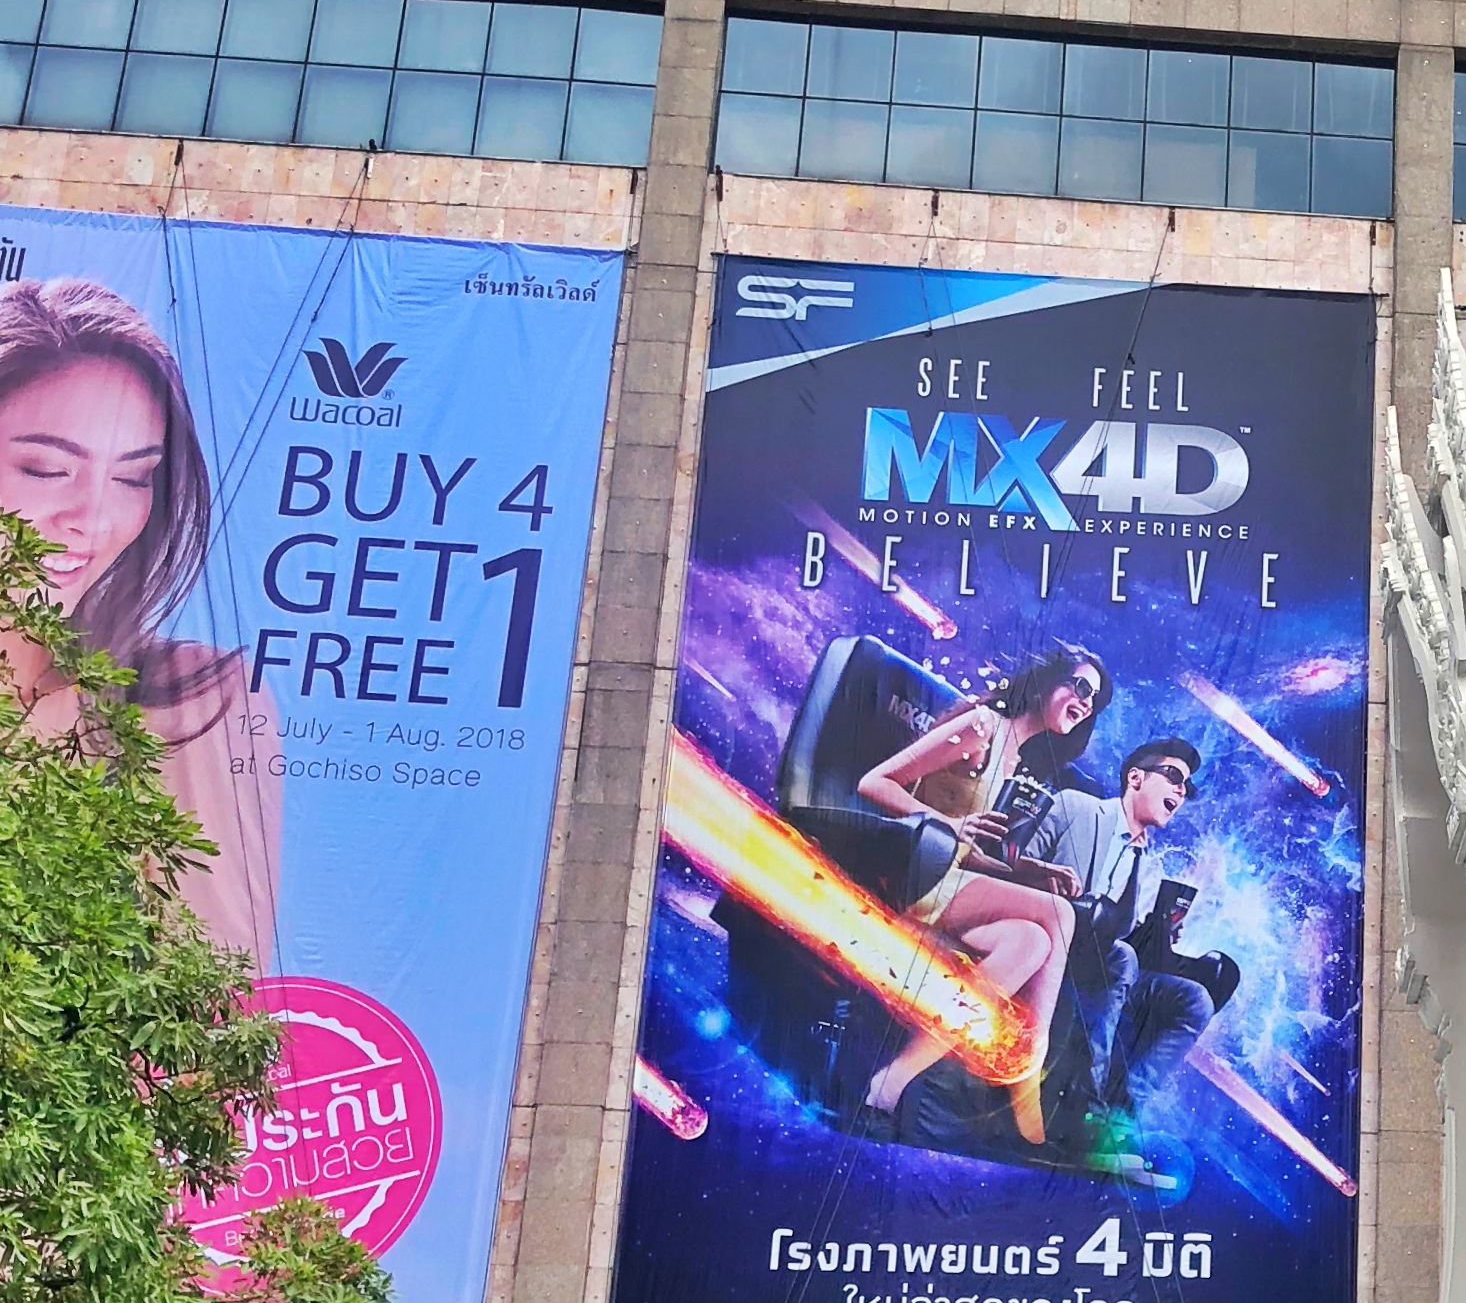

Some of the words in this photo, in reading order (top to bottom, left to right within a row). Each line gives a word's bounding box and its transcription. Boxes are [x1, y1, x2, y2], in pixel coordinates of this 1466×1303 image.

[464, 272, 600, 302] เซ็นทรัลเวิลด์
[736, 275, 855, 321] SF
[917, 357, 990, 400] SEE
[1092, 366, 1189, 412] FEEL
[289, 396, 402, 429] Wacoal
[277, 444, 477, 526] BUY
[497, 463, 554, 532] 4
[861, 406, 1250, 532] MX4D
[858, 508, 971, 527] MOTION
[988, 512, 1037, 530] EFX
[1083, 518, 1250, 539] EXPERIENCE
[803, 530, 1279, 609] BELIEVE
[262, 531, 477, 622] GET
[481, 547, 543, 709] 1
[249, 628, 456, 706] FREE
[238, 714, 268, 737] 12
[277, 716, 332, 745] July
[366, 721, 375, 743] 1
[386, 723, 446, 752] Aug.
[456, 726, 525, 750] 2018
[229, 756, 256, 775] at
[268, 754, 381, 782] Gochiso
[392, 762, 481, 789] Space
[768, 1228, 1064, 1276] โรงภาพยนตร์
[1076, 1218, 1128, 1276] 4
[1142, 1231, 1212, 1278] มิติ
